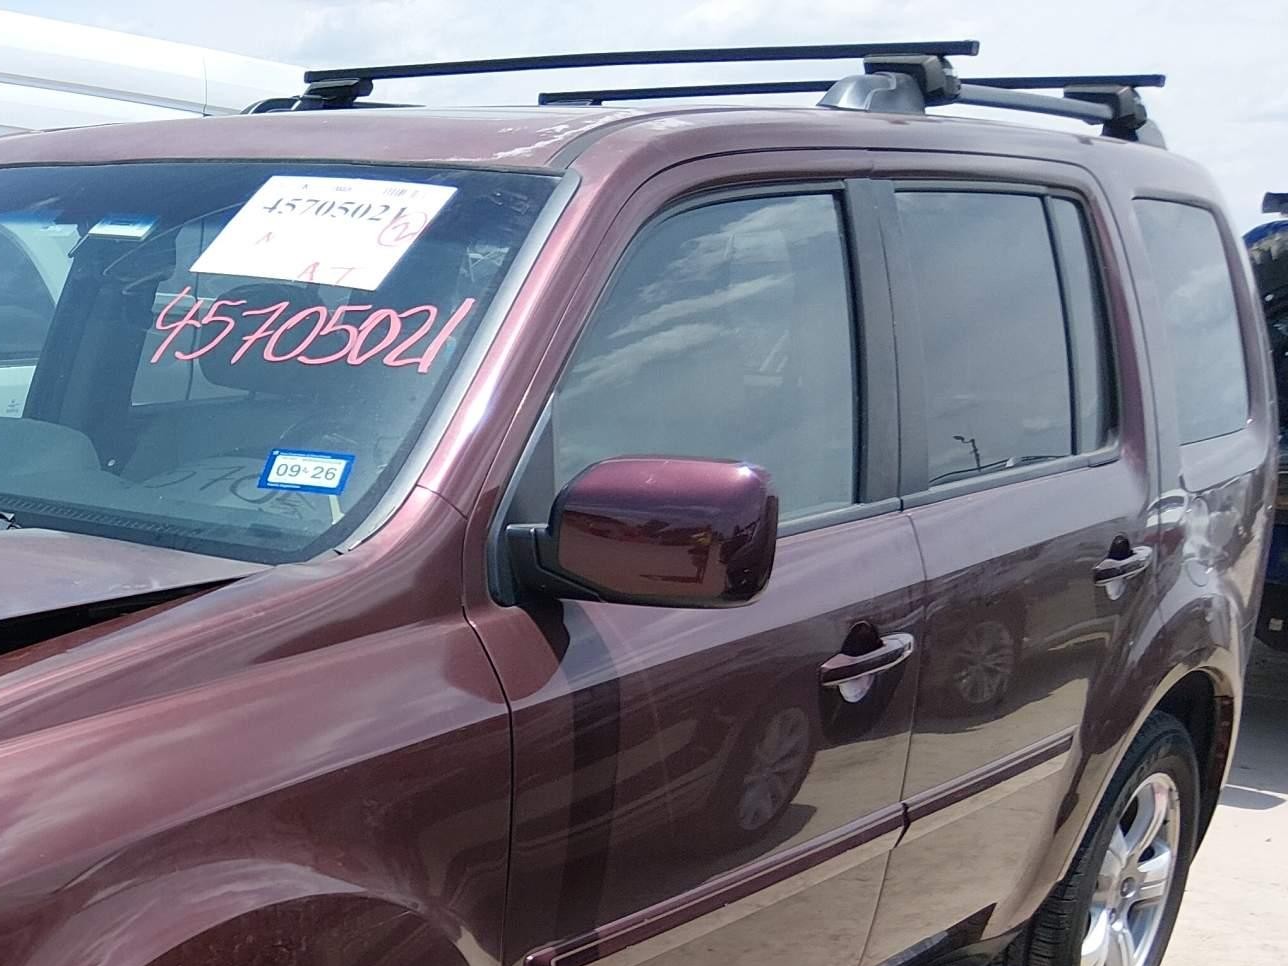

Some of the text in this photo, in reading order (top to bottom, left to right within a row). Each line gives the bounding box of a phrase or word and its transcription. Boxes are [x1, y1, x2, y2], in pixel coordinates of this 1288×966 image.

[263, 198, 409, 222] 45705021
[151, 287, 475, 372] 45705021
[275, 463, 338, 481] 09 26
